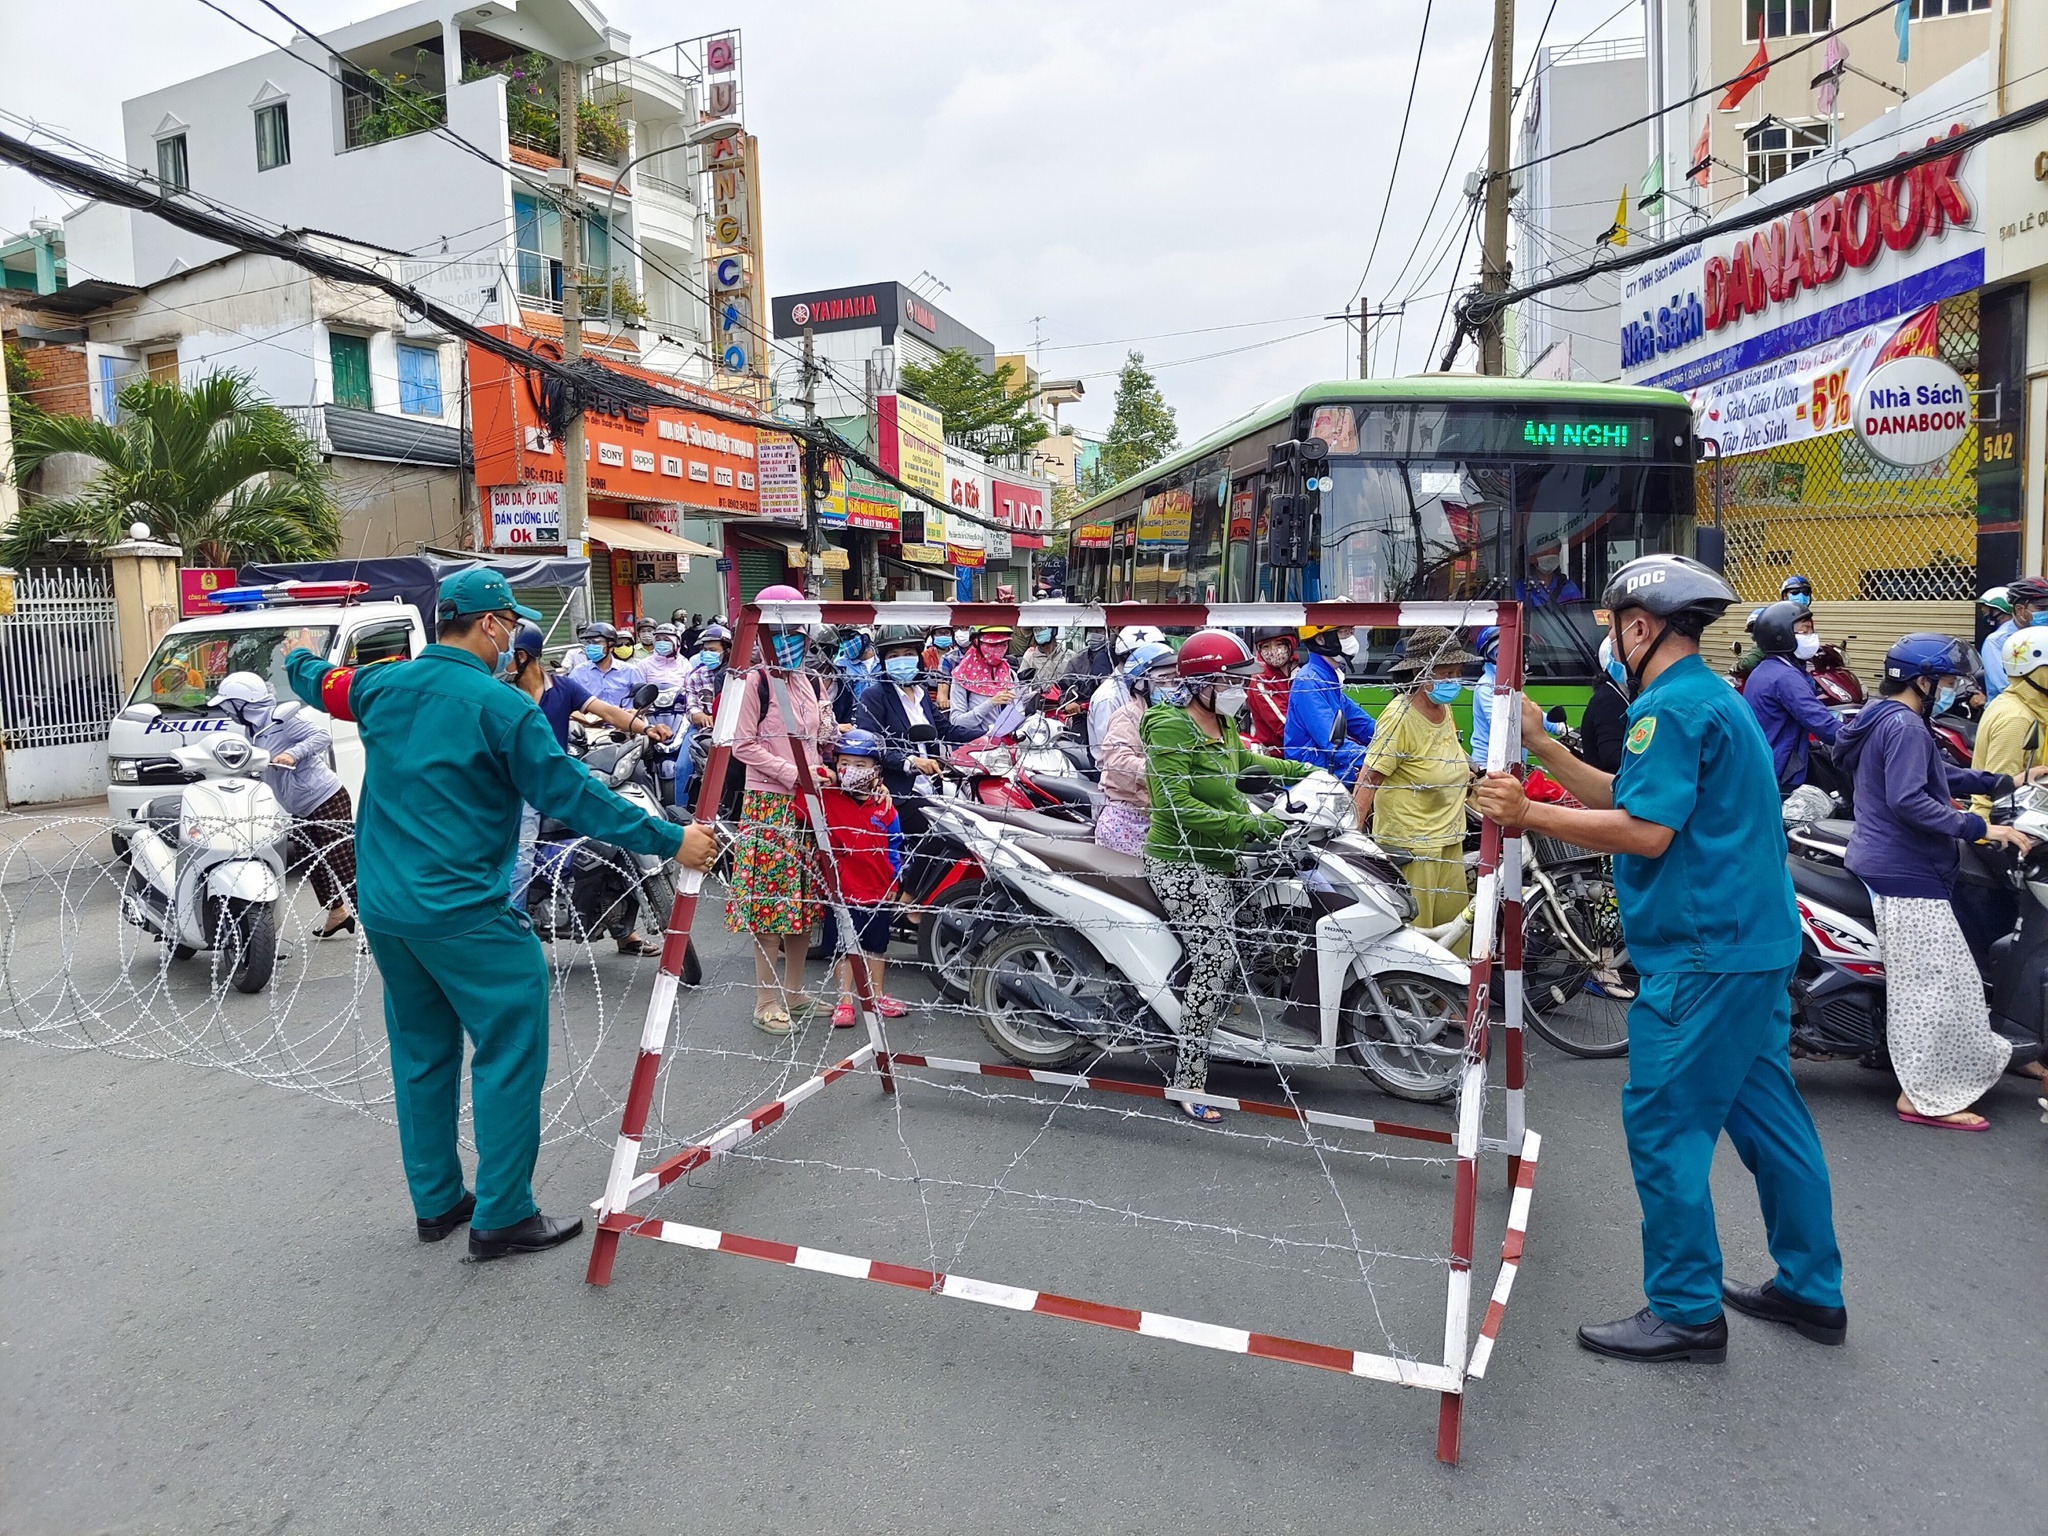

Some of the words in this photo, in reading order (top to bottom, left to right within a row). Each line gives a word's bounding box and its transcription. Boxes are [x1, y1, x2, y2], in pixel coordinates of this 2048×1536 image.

[1704, 122, 1970, 331] DANABOOK
[2020, 212, 2034, 234] LÊ
[1626, 283, 1638, 299] CTY
[1638, 276, 1653, 293] TNHH
[1654, 266, 1669, 284] Sách
[1669, 244, 1703, 276] DANABOOK
[809, 294, 877, 323] YAMAHA
[913, 302, 936, 334] YAMAHA
[1621, 310, 1656, 370] Nhà
[1656, 291, 1704, 354] Sách
[1723, 400, 1746, 424] Sách
[1748, 390, 1771, 418] Giáo
[1772, 386, 1799, 411] Khoa
[1812, 367, 1850, 431] 5%
[1870, 385, 1911, 410] Nhà
[1916, 383, 1963, 406] Sách
[1563, 424, 1628, 447] NGHI
[1865, 410, 1966, 436] DANABOOK
[1721, 430, 1740, 455] Tập
[1763, 418, 1788, 445] Sinh
[1983, 431, 2014, 462] 542
[600, 448, 623, 461] SONY
[633, 454, 654, 466] oppo
[525, 466, 538, 480] ĐC:
[539, 470, 554, 482] 473
[555, 470, 563, 484] LÊ
[746, 476, 753, 487] LG
[495, 492, 509, 506] BAO
[512, 491, 525, 507] DA,
[526, 487, 537, 505] ỐP
[748, 501, 758, 512] 222
[951, 478, 963, 506] Cà
[965, 477, 980, 510] Rốt
[495, 510, 512, 525] DÁN
[514, 509, 541, 525] CƯỜNG
[544, 510, 560, 526] LỰC
[1003, 498, 1043, 531] JUNO
[510, 528, 532, 543] Ok
[144, 719, 230, 735] POLICE
[1324, 926, 1353, 935] HONDA
[1807, 917, 1878, 952] GTX
